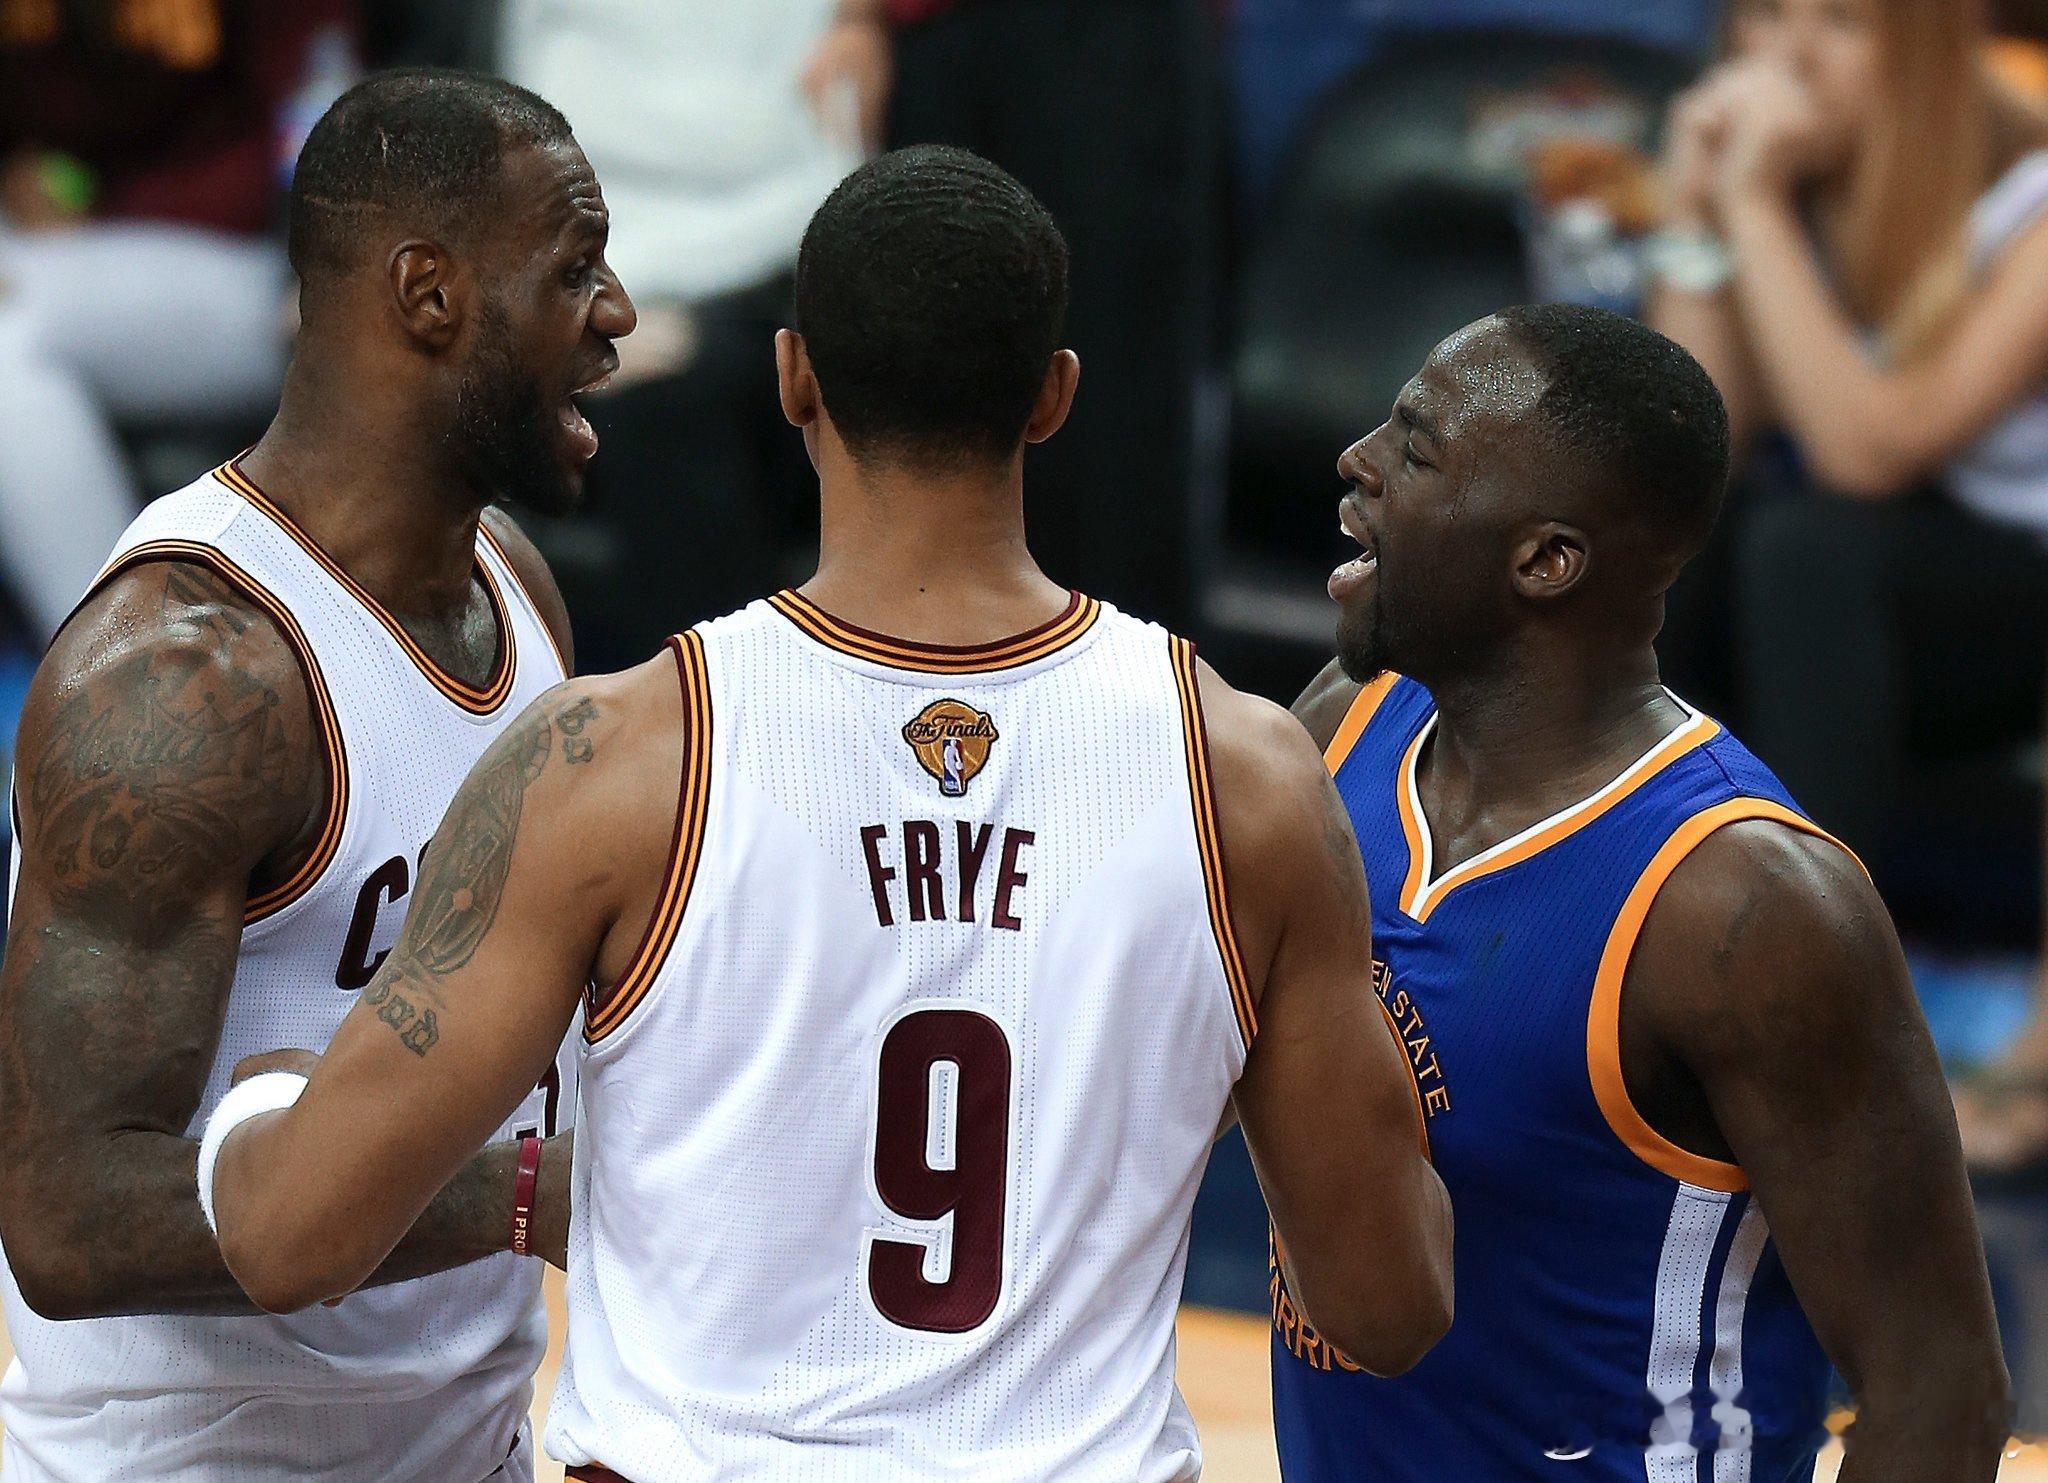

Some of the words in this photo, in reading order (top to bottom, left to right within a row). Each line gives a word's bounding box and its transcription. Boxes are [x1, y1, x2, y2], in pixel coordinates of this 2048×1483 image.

[931, 714, 993, 739] Finals
[335, 840, 432, 991] C
[860, 819, 1036, 931] FRYE
[1392, 990, 1451, 1118] STATE
[868, 1009, 1012, 1334] 9
[514, 1217, 527, 1254] PRO
